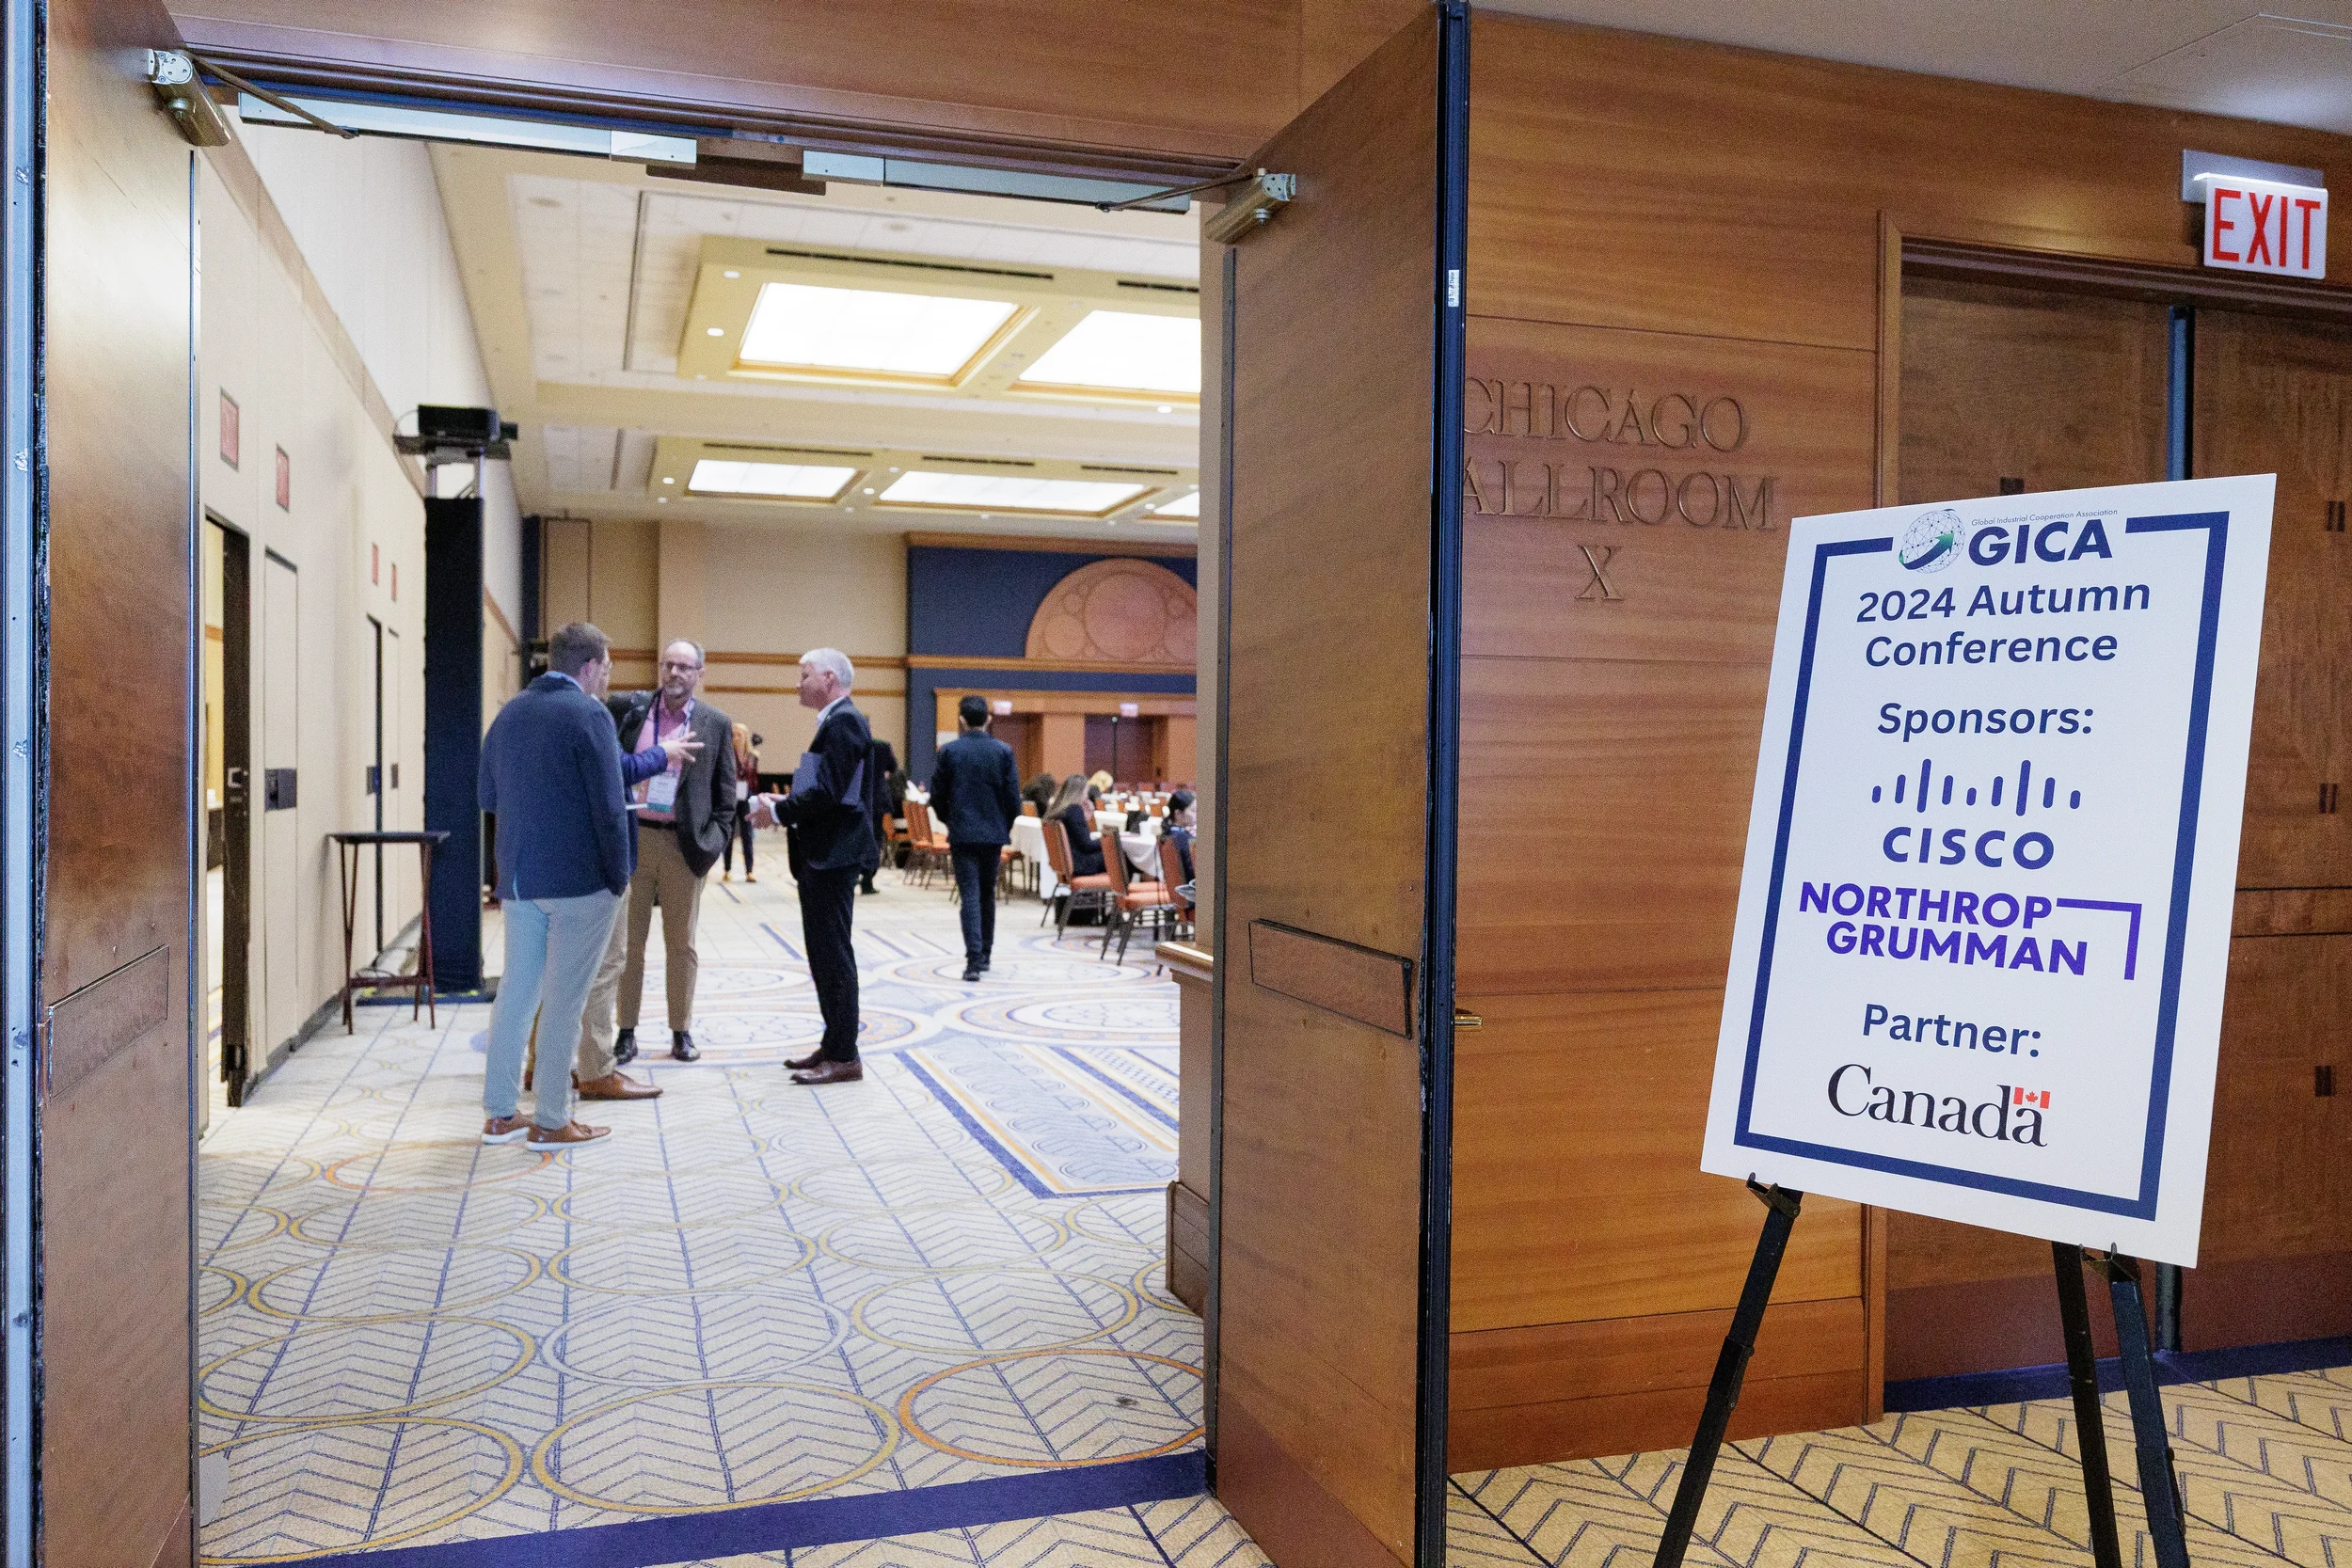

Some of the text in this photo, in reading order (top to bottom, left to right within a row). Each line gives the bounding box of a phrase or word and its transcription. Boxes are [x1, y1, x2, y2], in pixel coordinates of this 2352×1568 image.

[2212, 187, 2321, 270] EXIT
[1464, 376, 1748, 452] CHICAGO
[1463, 455, 1778, 531] ALLROOM
[1971, 509, 2118, 527] Global Industrial Cooperation Association
[1968, 518, 2113, 566] GICA
[1575, 544, 1625, 602] X
[1856, 583, 2151, 623] 2024 Autumn
[1866, 630, 2118, 667] Conference
[1877, 702, 2094, 743] Sponsors:
[1883, 826, 2055, 870] CISCO
[1799, 881, 2052, 929] NORTHROP
[1826, 921, 2088, 976] GRUMMAN
[1863, 1003, 2042, 1058] Partner:
[1827, 1063, 2048, 1148] Canada
